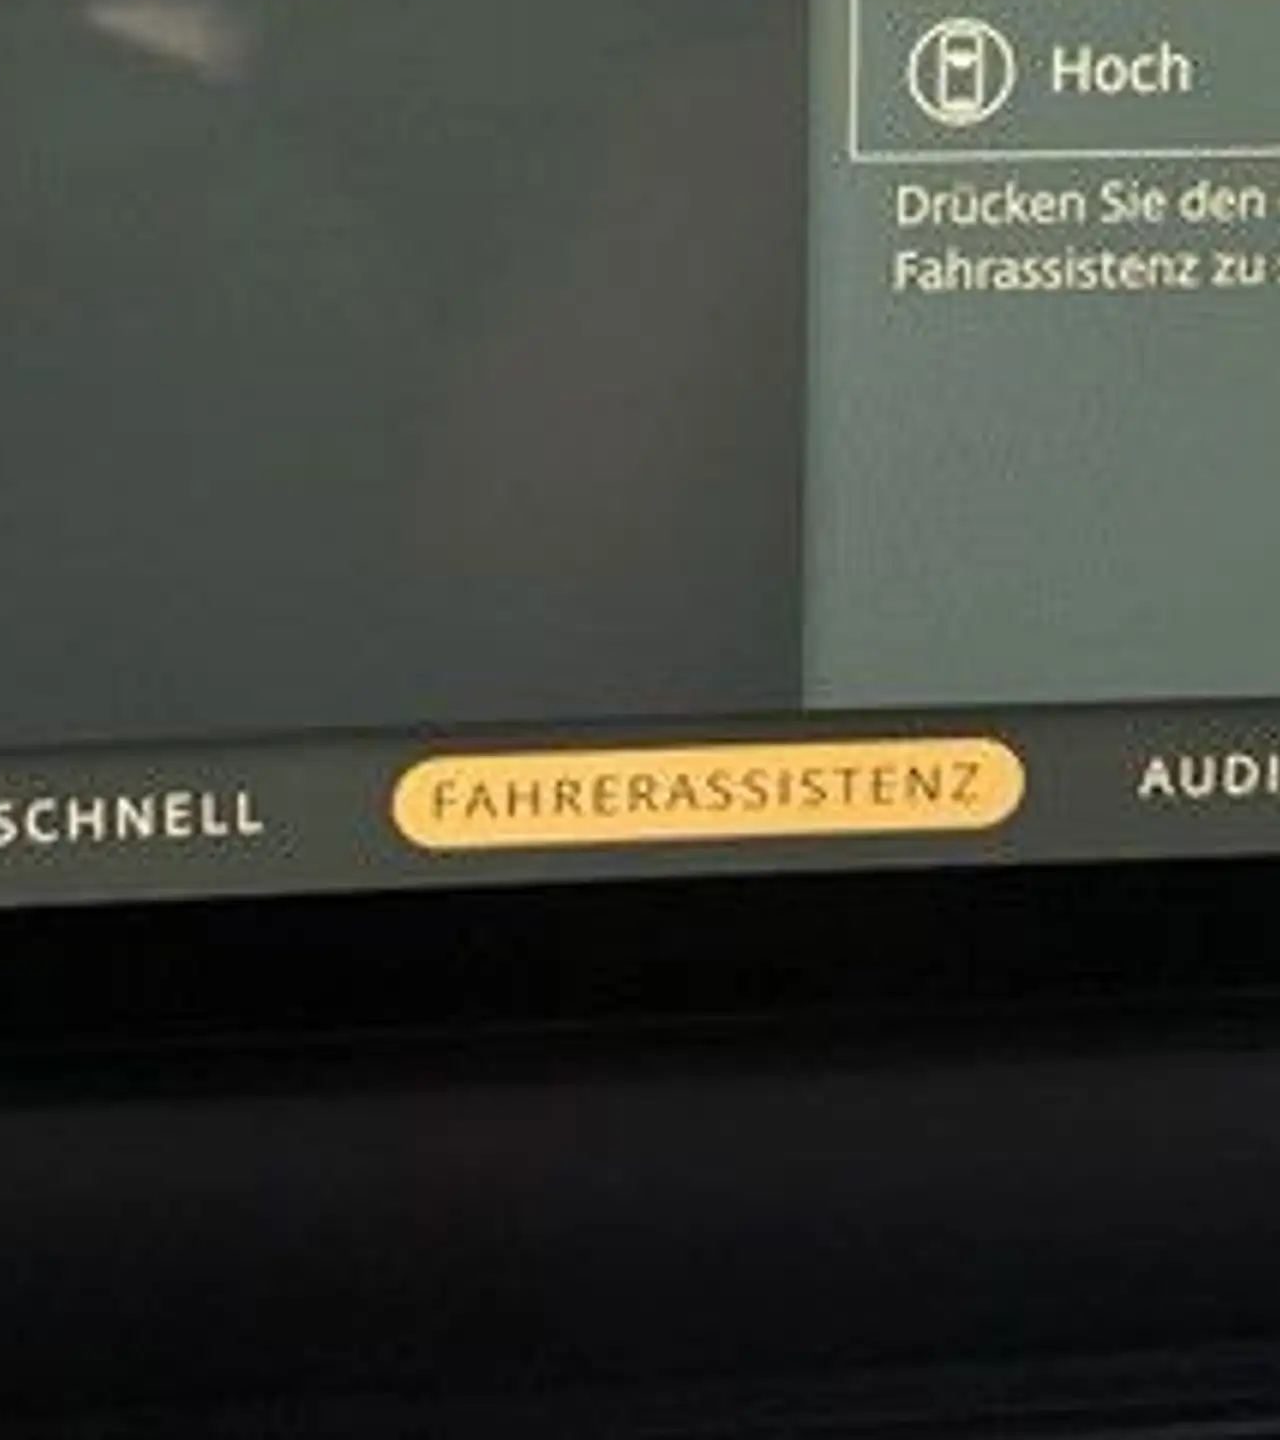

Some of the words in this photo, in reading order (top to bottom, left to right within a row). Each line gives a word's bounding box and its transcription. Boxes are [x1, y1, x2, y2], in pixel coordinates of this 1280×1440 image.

[1051, 40, 1191, 95] Hoch
[896, 180, 1087, 227] Drücken
[1099, 179, 1168, 225] Sie
[1178, 178, 1267, 223] den
[893, 248, 1200, 292] Fahrassistenz
[1210, 251, 1267, 287] zu
[429, 764, 986, 823] FAHRERASSISTENZ
